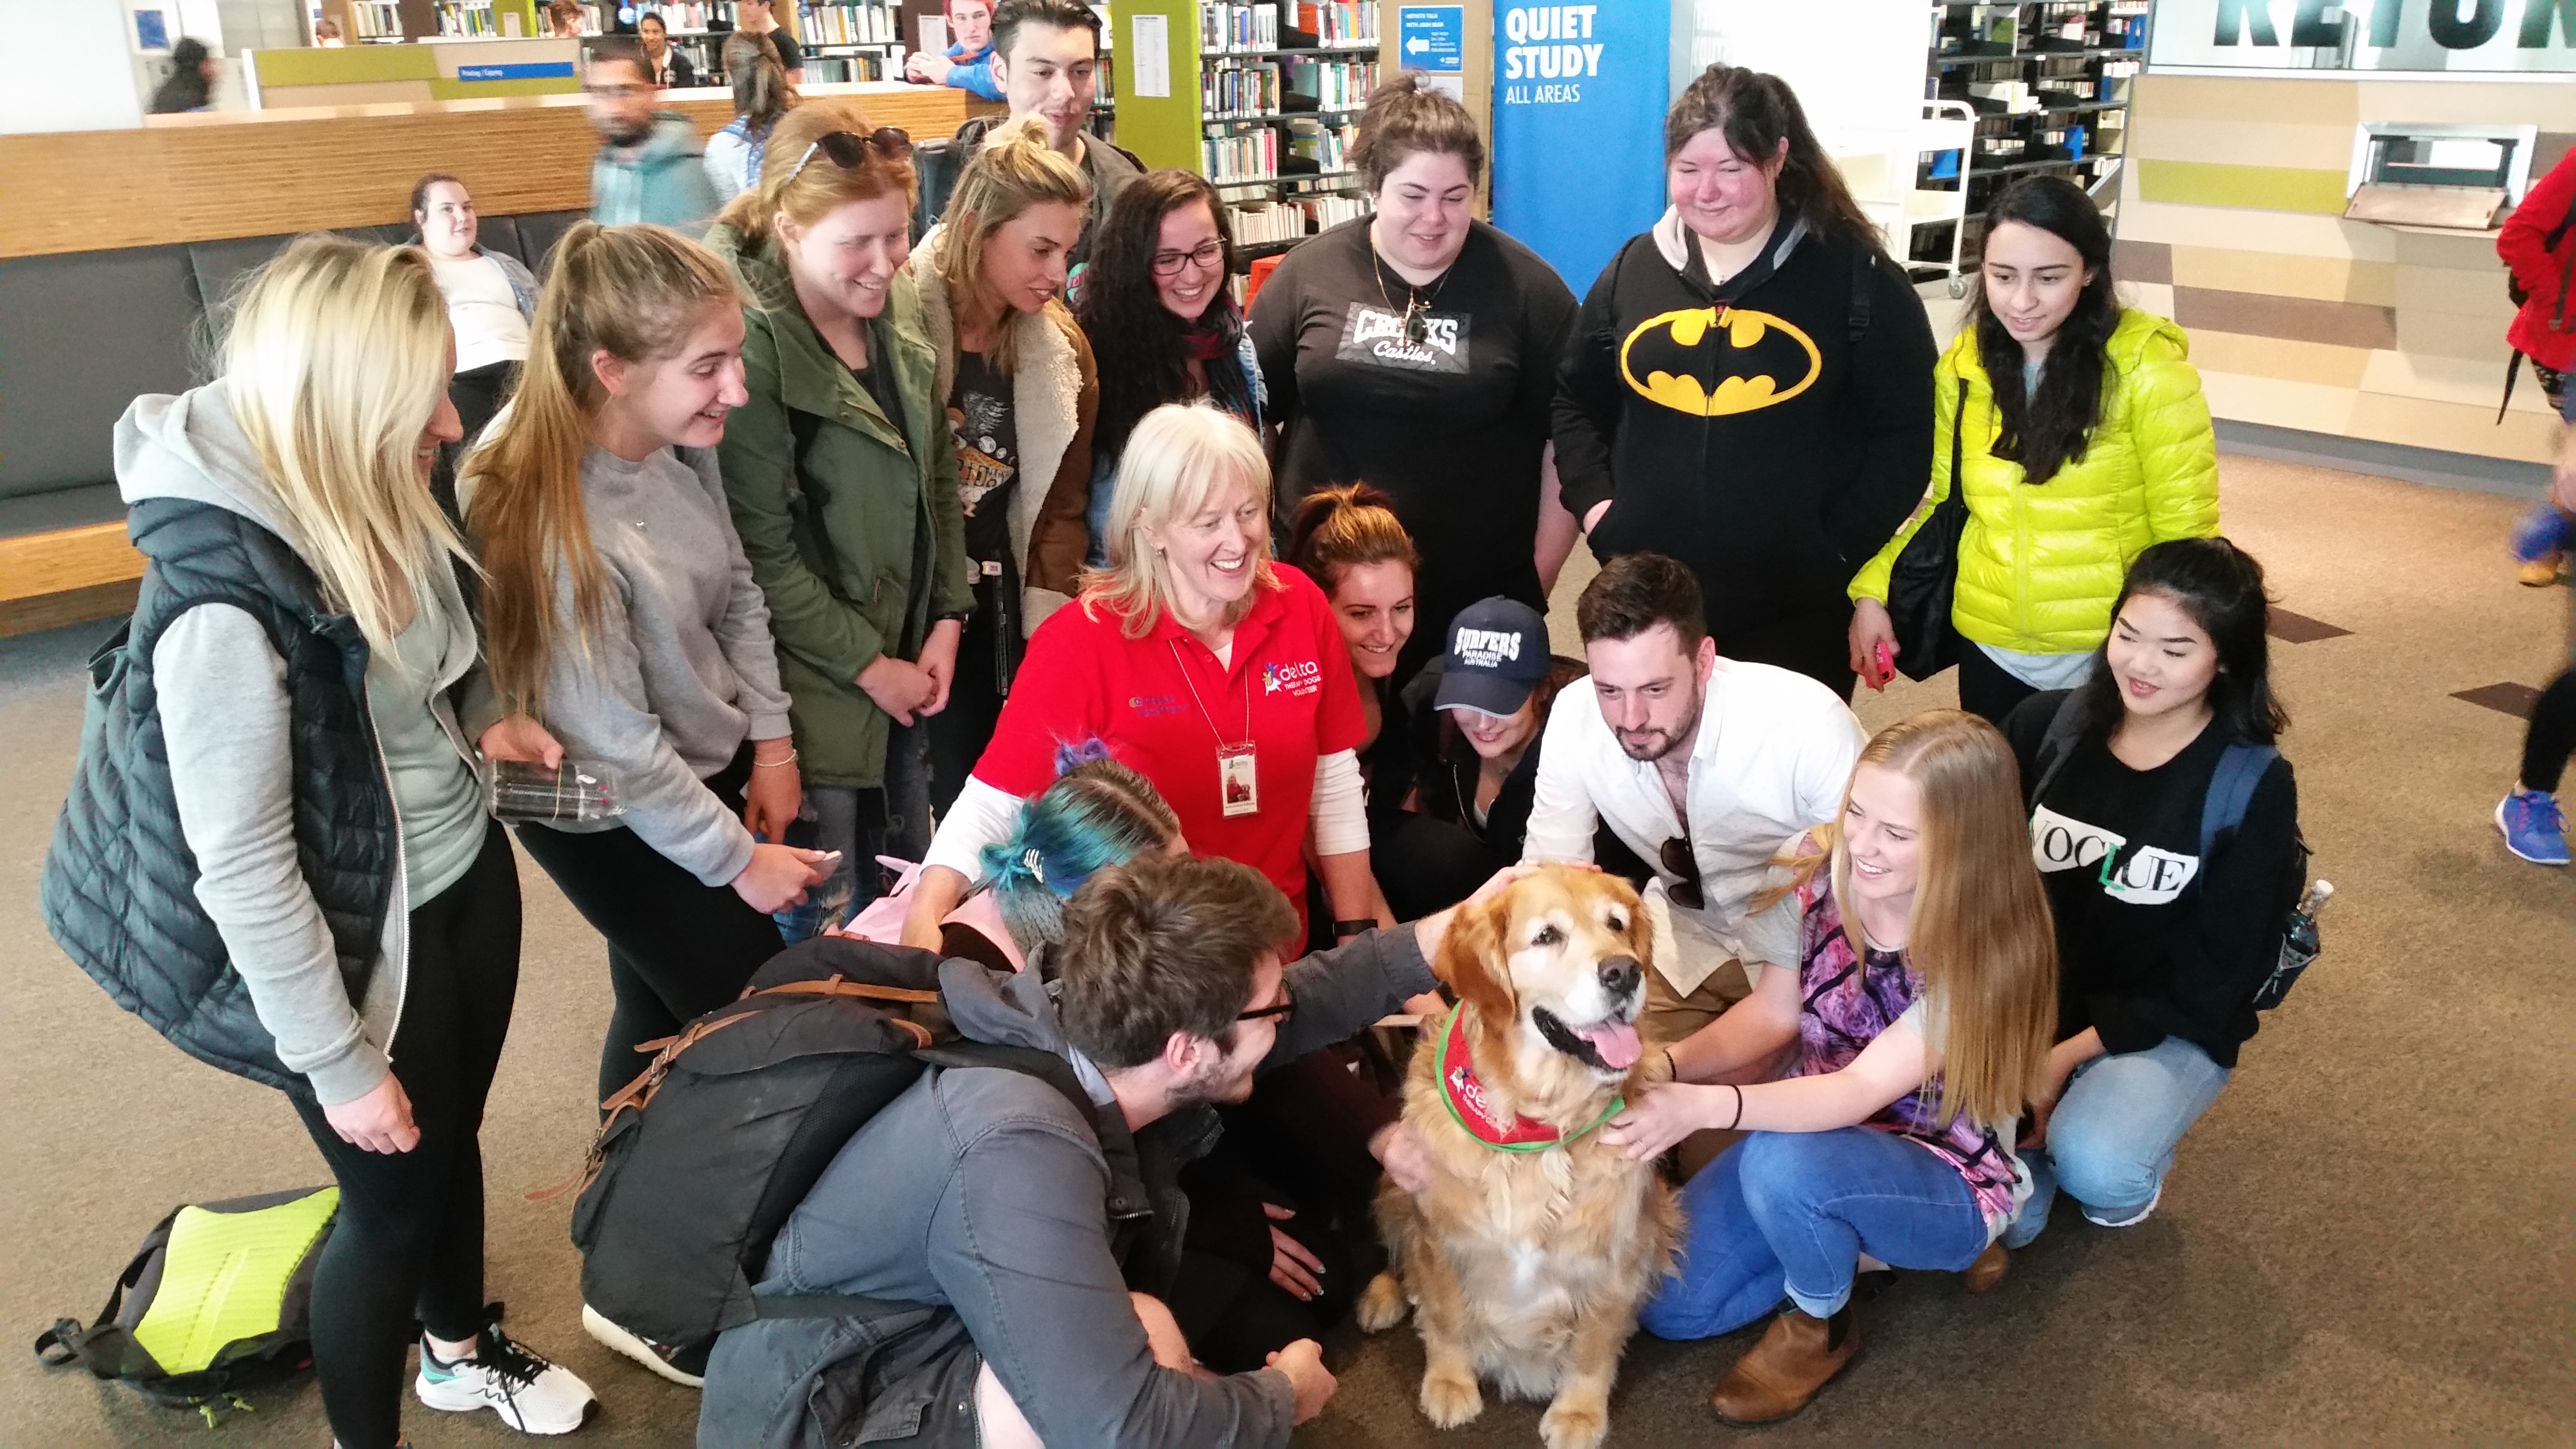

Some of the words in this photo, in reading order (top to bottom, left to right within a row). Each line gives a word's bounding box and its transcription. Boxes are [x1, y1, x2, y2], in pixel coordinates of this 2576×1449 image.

[1506, 5, 1597, 45] QUIET
[1506, 44, 1604, 80] STUDY
[1505, 85, 1531, 104] ALL
[1534, 83, 1580, 103] AREAS
[1454, 627, 1521, 661] SURFERS
[1462, 649, 1503, 662] PARADISE
[1464, 659, 1498, 668] AUSTRALIA
[1280, 661, 1318, 681] delta
[1303, 675, 1321, 686] DOGS
